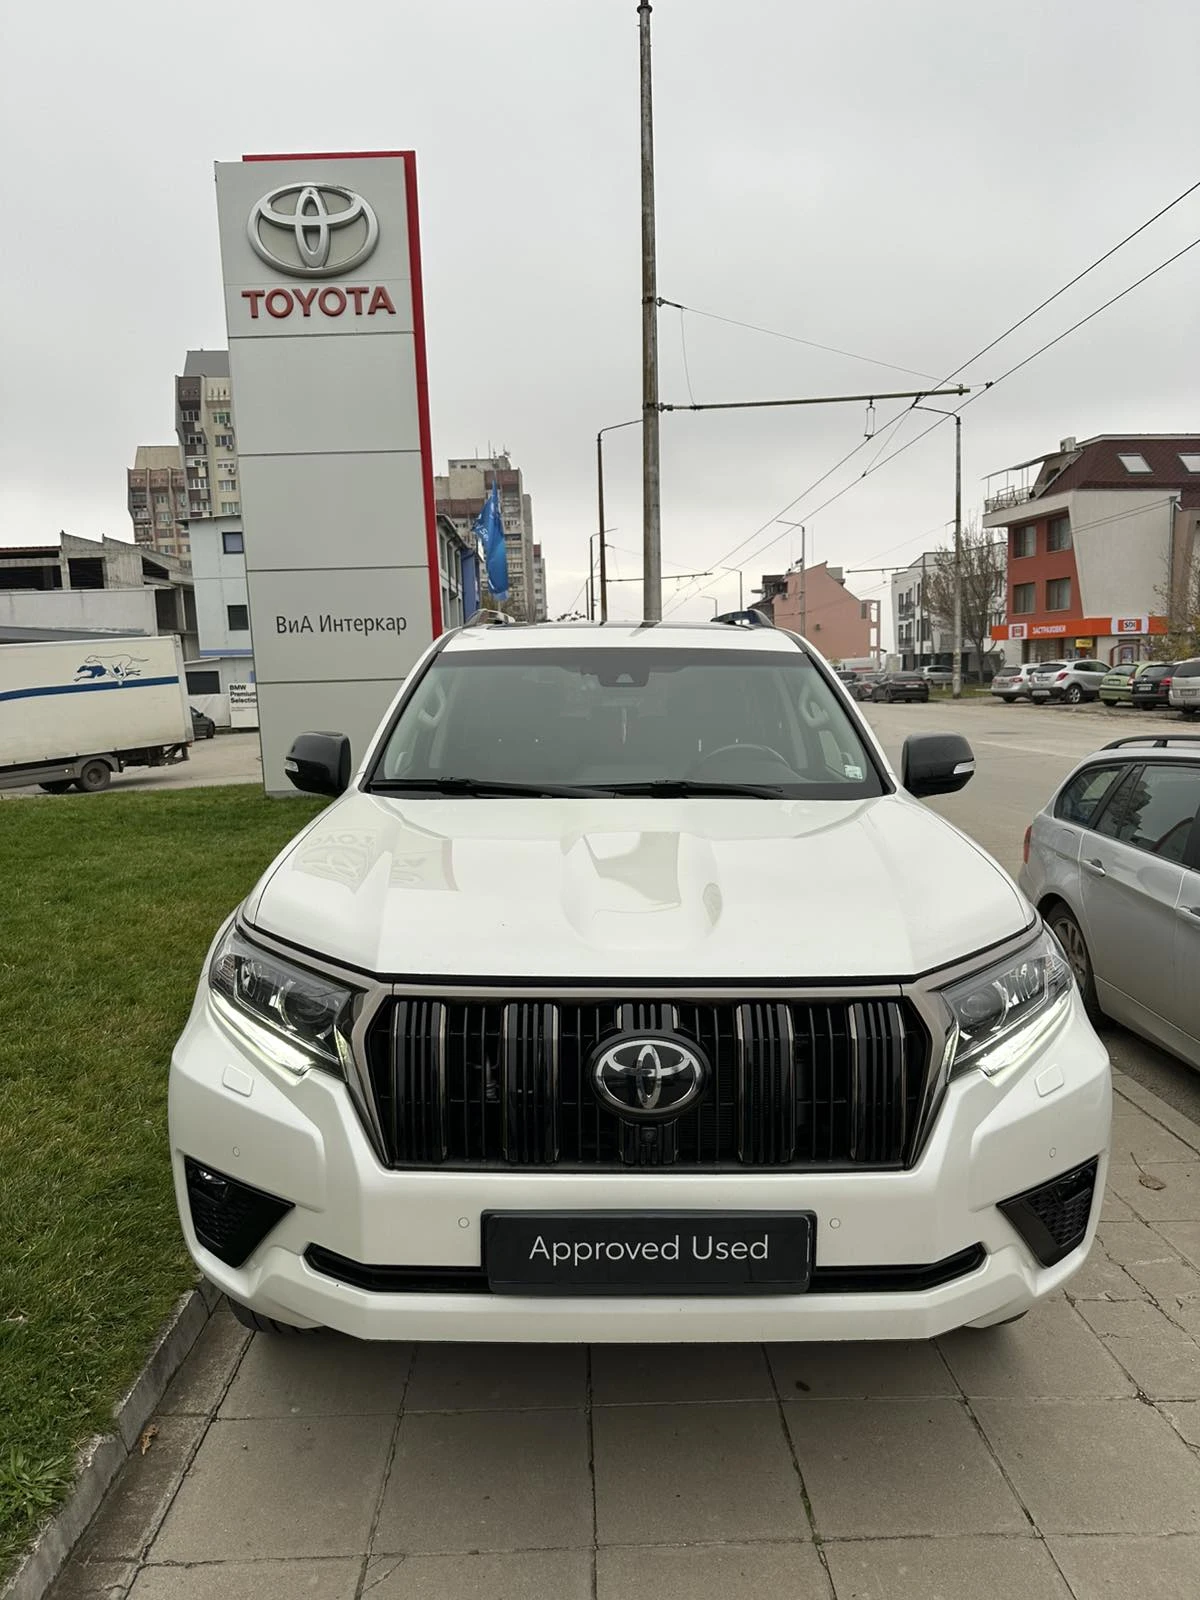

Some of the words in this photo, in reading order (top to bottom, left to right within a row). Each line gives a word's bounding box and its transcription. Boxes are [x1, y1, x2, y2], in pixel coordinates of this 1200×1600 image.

[241, 286, 396, 319] TOYOTA
[276, 615, 314, 634] ВиА
[319, 614, 407, 636] Интеркар
[529, 1234, 680, 1267] Approved
[692, 1234, 769, 1261] Used
